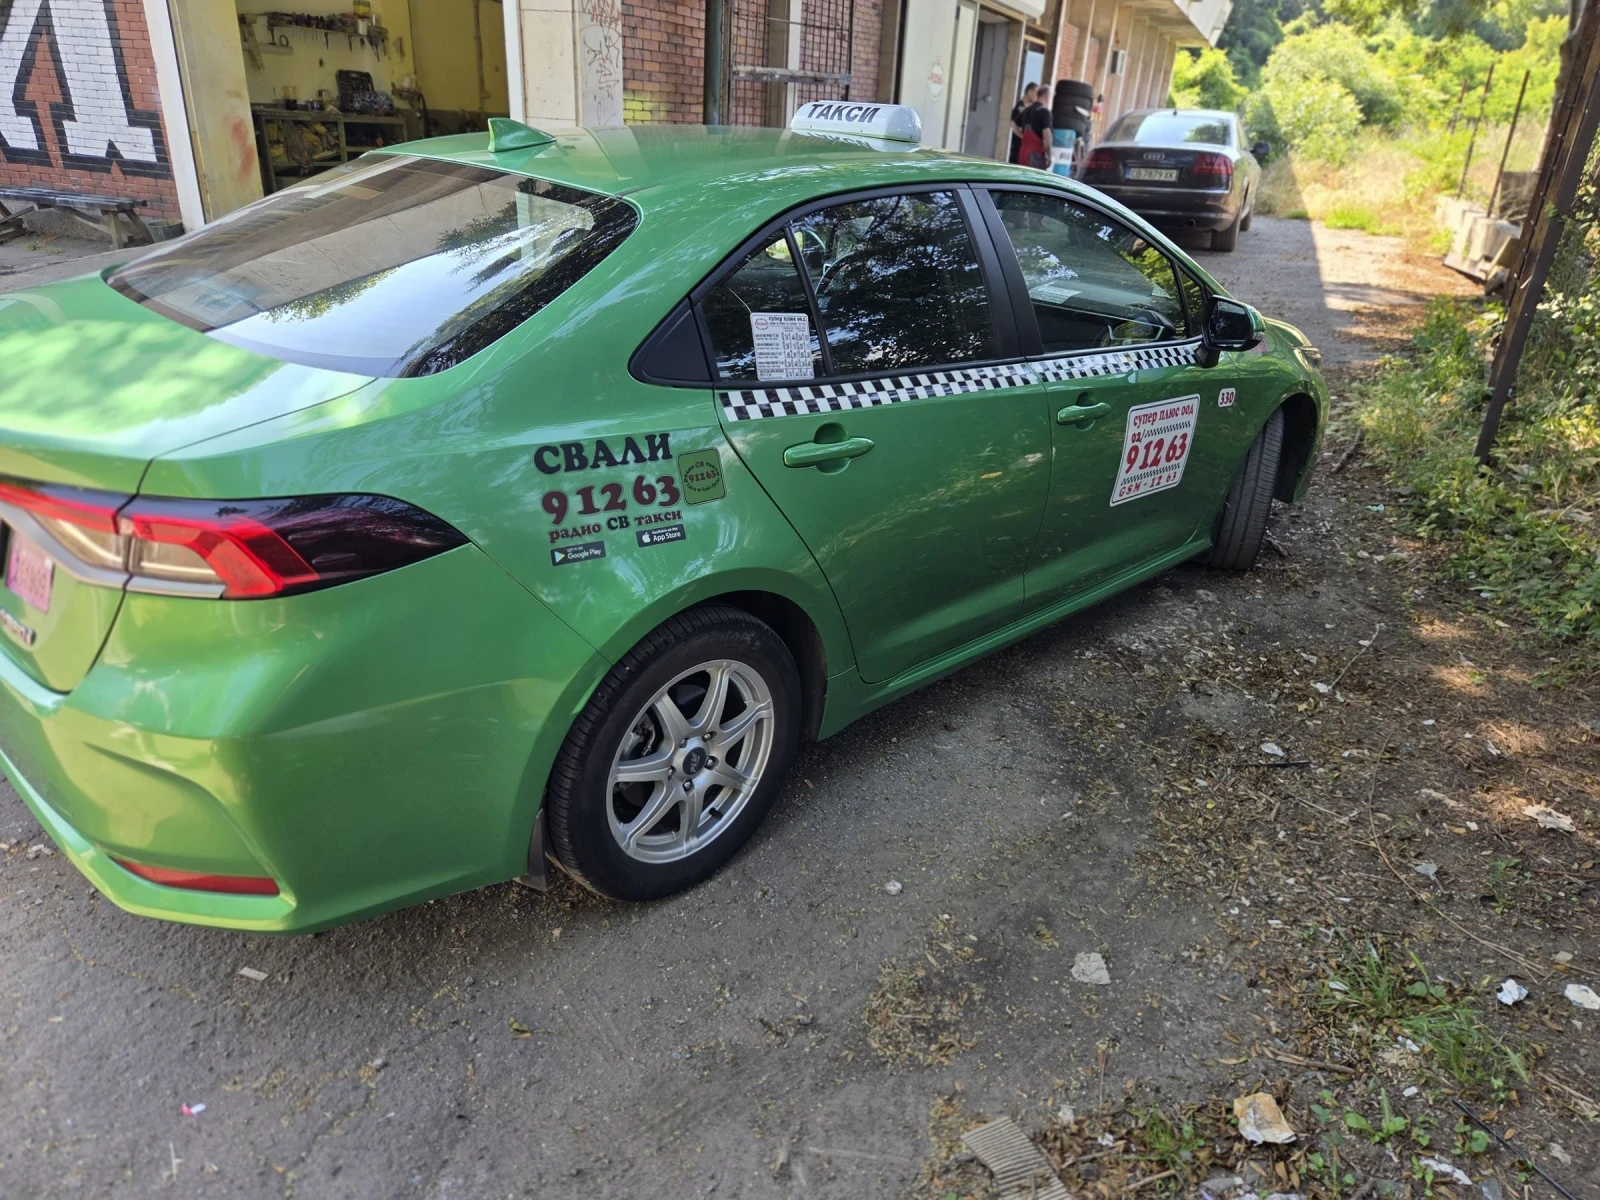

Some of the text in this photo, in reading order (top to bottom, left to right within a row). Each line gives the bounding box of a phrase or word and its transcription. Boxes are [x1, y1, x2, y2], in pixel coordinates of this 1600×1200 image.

[807, 103, 881, 123] ТАКСИ
[1219, 391, 1235, 405] 330
[534, 433, 673, 475] СВАЛИ
[1119, 480, 1142, 497] GSM
[548, 510, 682, 544] радио СВ такси
[653, 531, 682, 543] App Store
[567, 548, 602, 560] Google Play
